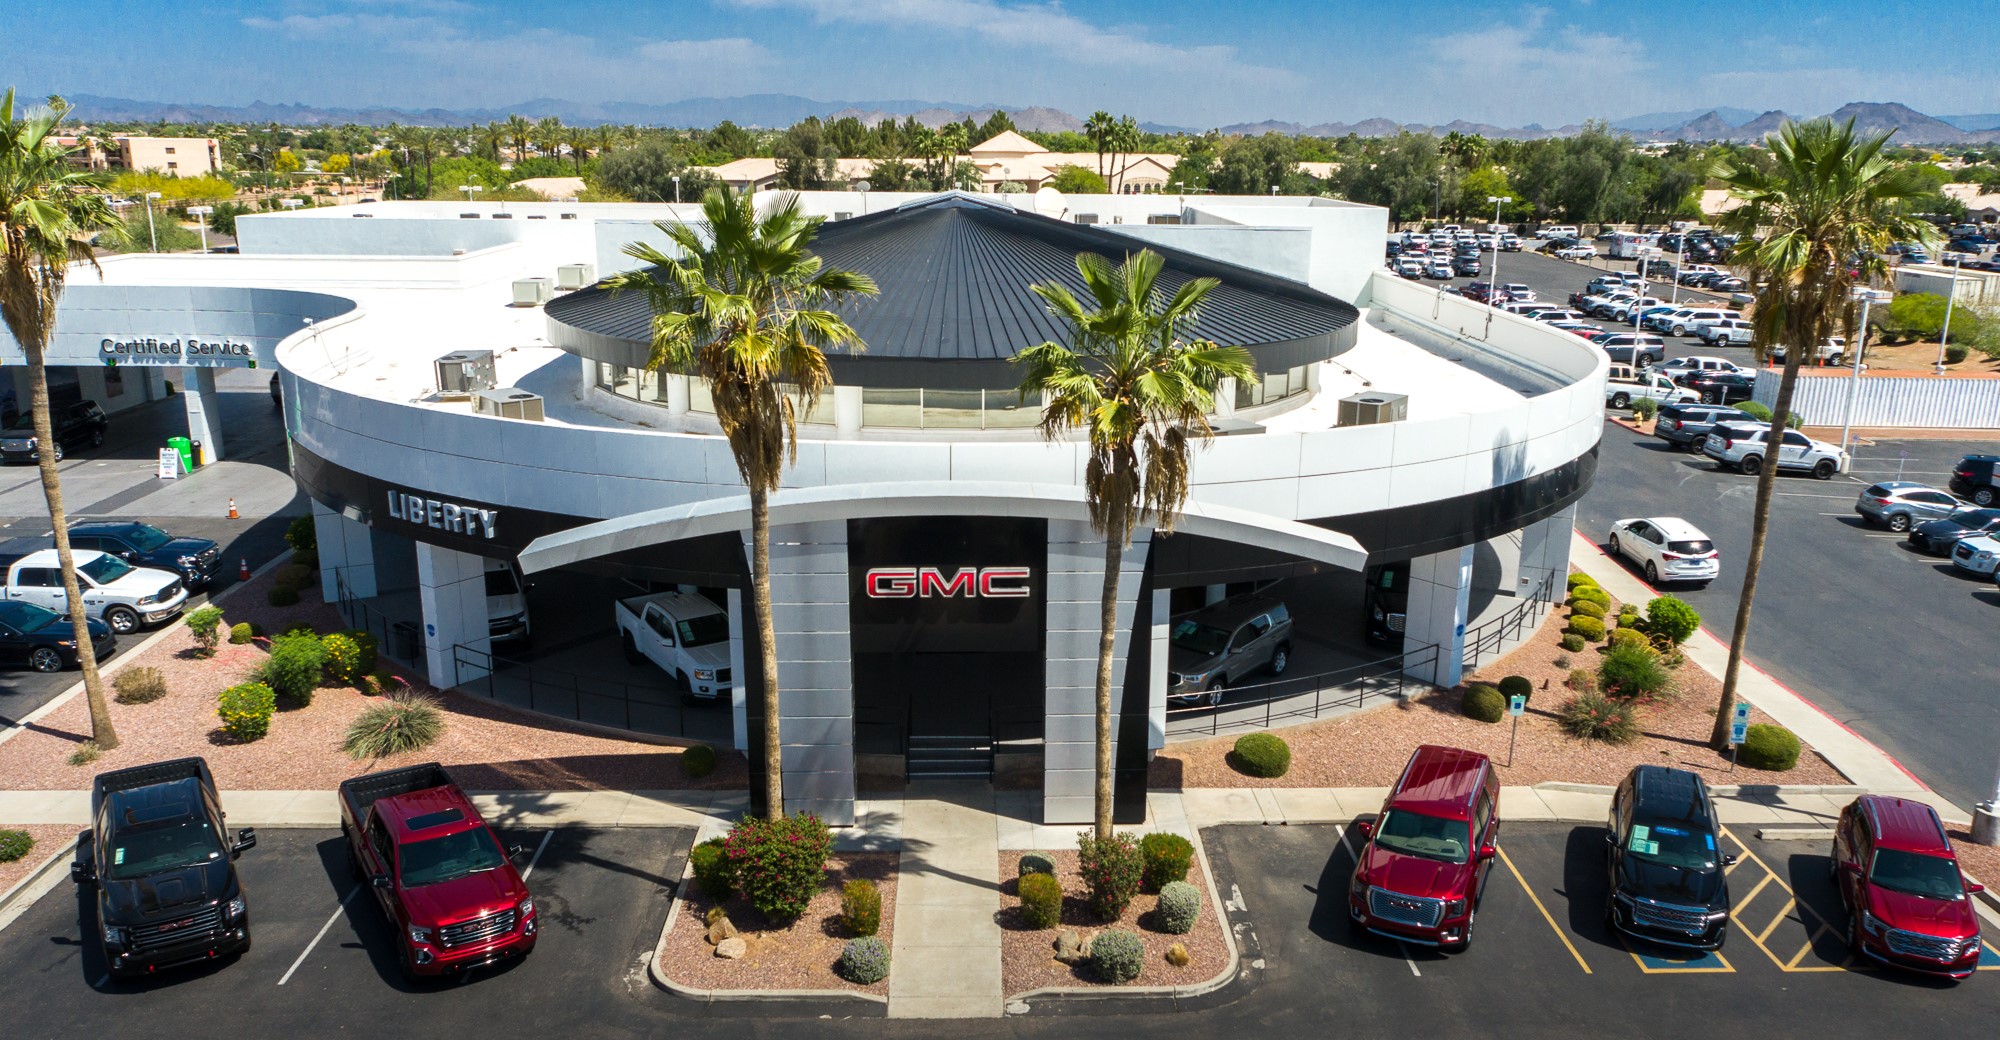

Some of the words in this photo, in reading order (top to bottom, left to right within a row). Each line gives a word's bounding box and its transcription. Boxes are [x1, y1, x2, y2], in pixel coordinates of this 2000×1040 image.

[101, 338, 182, 355] Certified
[187, 339, 252, 356] Service
[387, 490, 498, 539] LIBERTY
[866, 567, 1030, 598] GMC
